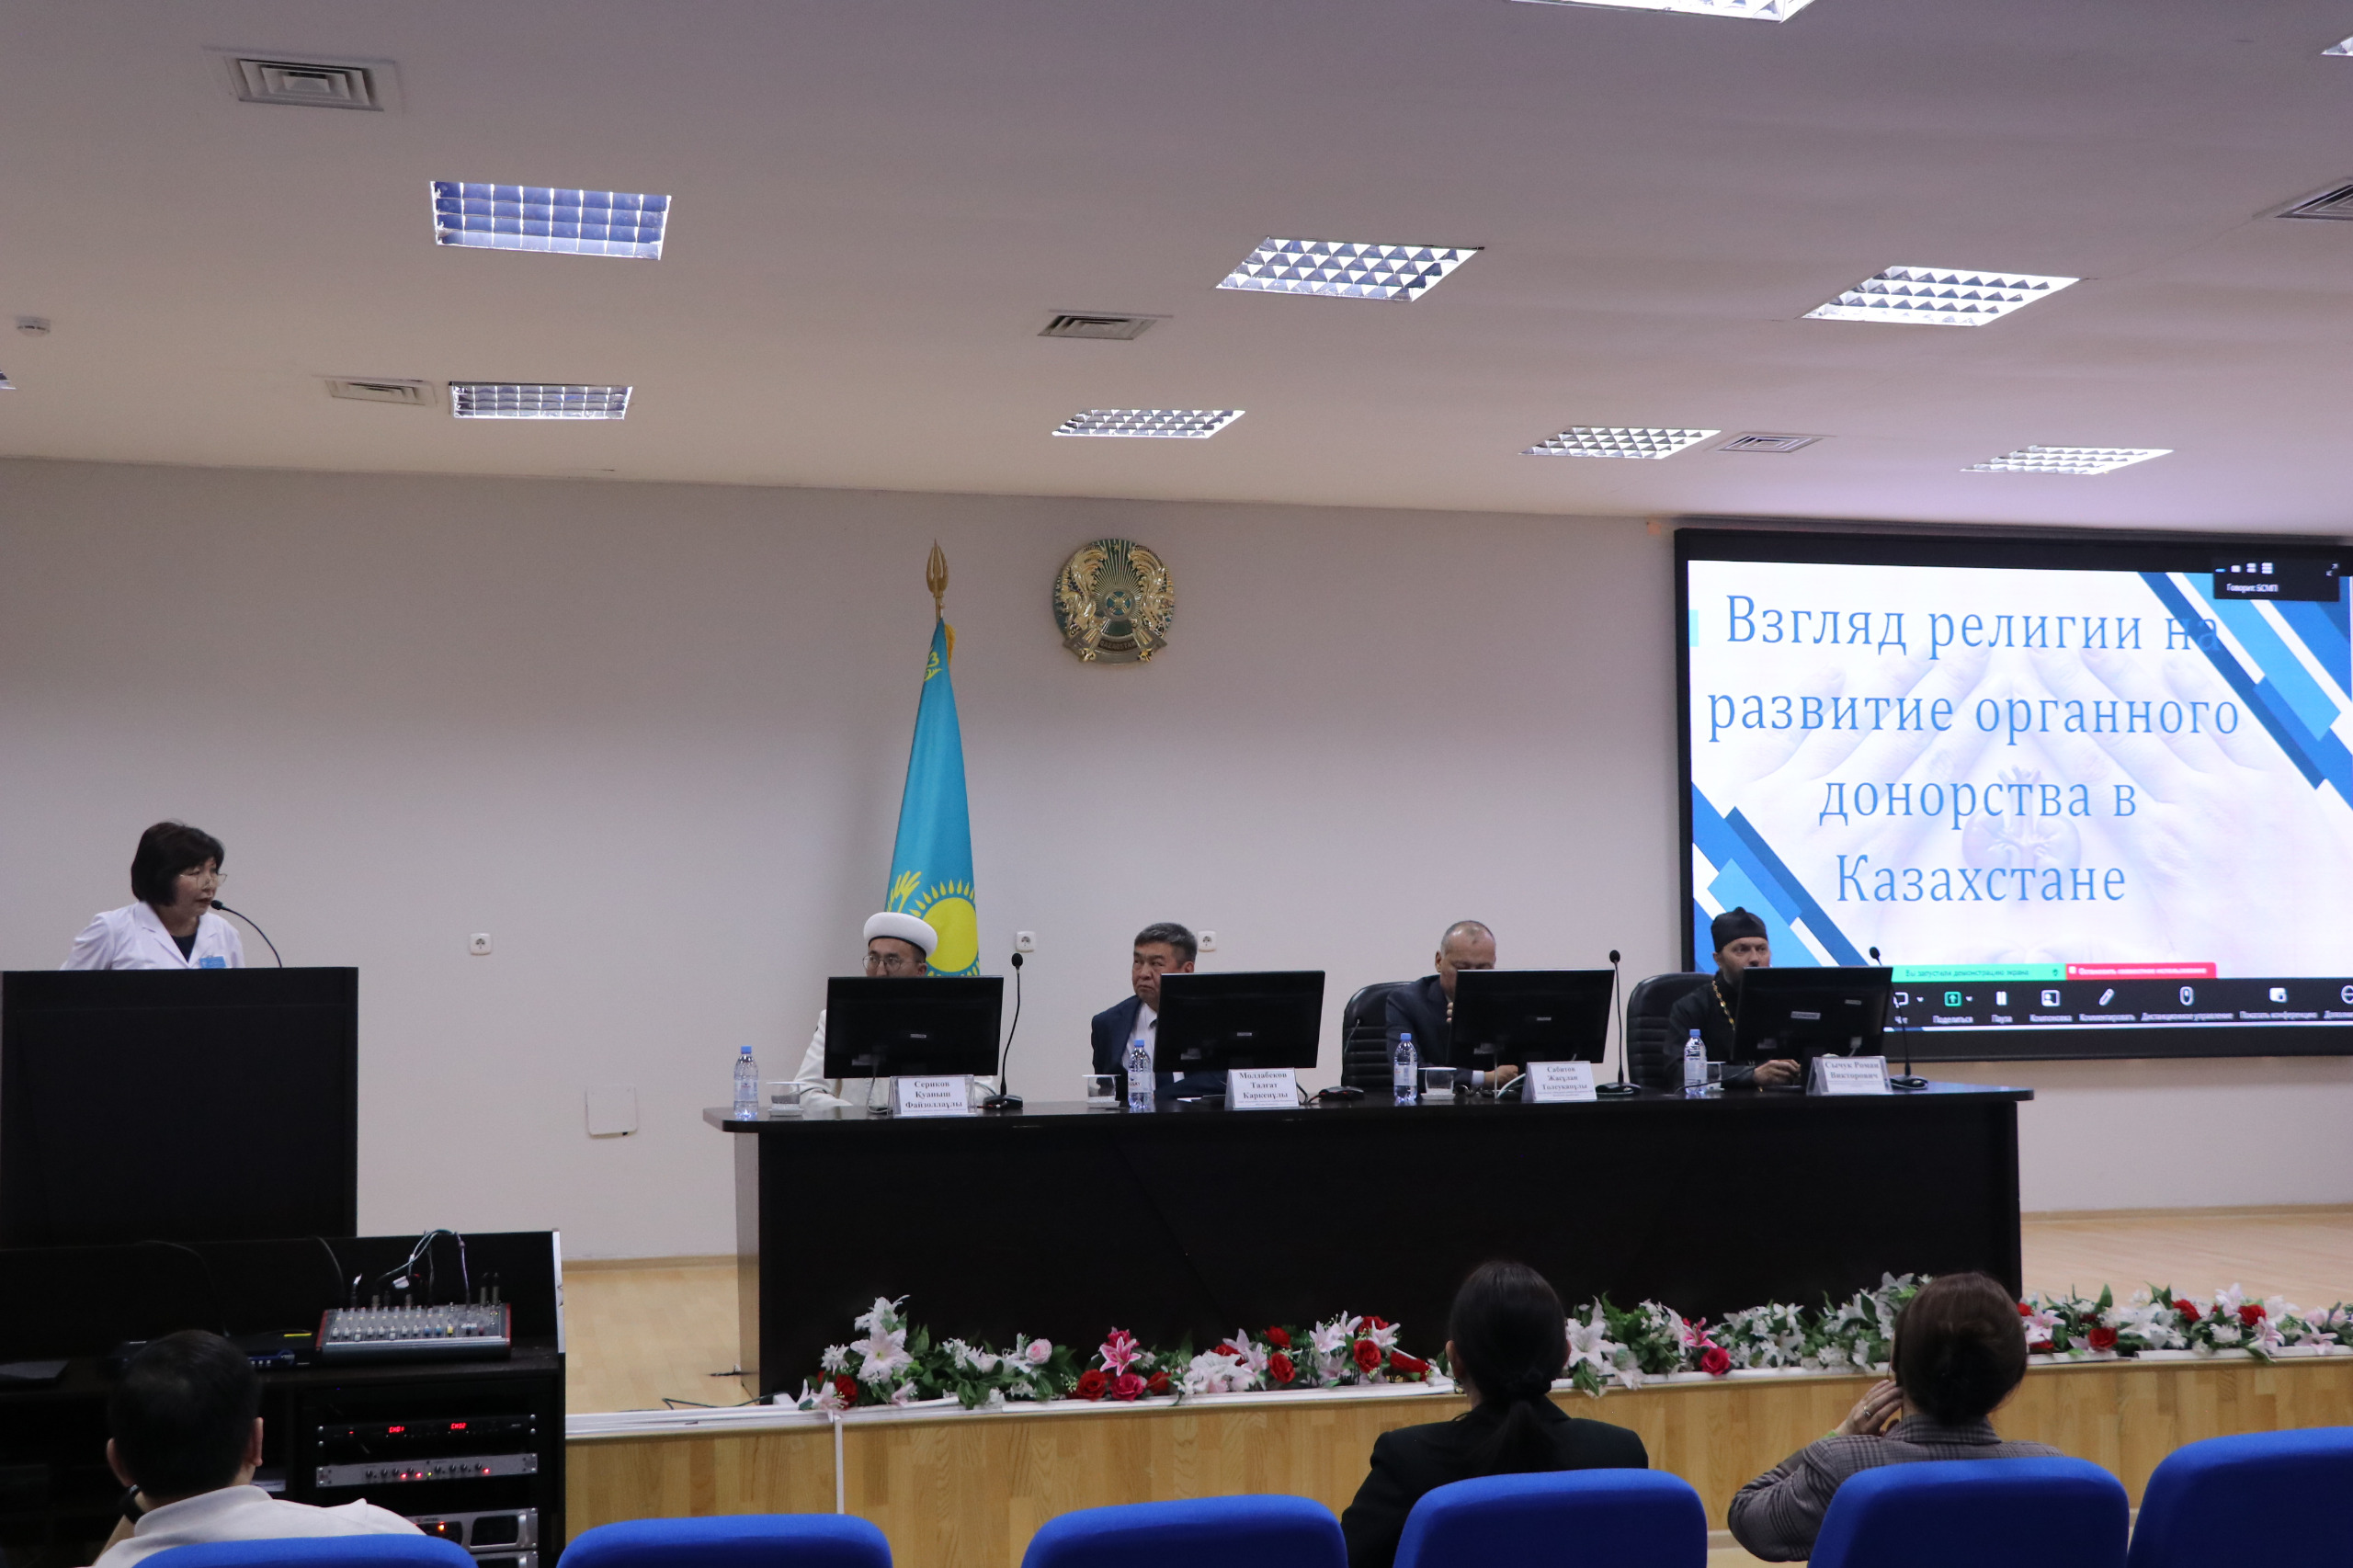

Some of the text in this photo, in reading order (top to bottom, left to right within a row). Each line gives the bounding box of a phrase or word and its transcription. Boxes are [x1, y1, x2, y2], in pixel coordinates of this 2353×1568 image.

[1726, 595, 2221, 661] Взгляд религии на
[1708, 692, 2239, 745] развитие органного
[1819, 782, 2136, 831] донорства в
[1836, 854, 2125, 903] Казахстане
[914, 1081, 949, 1089] Сериков
